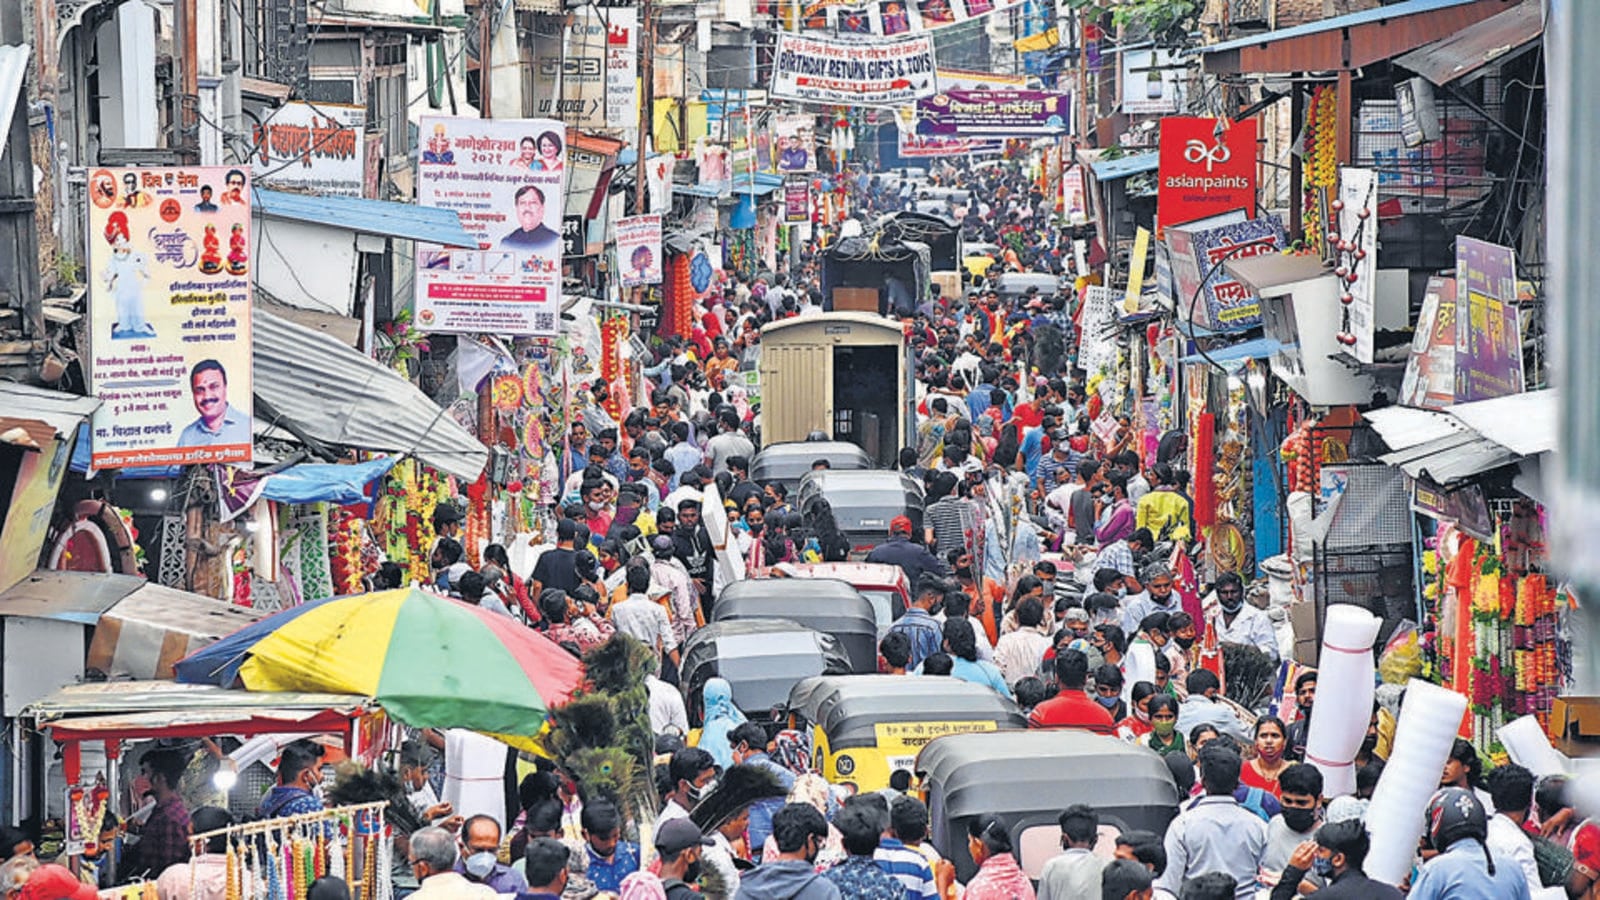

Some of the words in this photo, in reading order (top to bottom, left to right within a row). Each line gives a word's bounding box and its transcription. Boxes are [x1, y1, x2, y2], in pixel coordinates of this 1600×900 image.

[780, 51, 827, 77] BIRTHDAY
[829, 59, 865, 80] RETURN
[868, 60, 895, 79] GIFTS
[906, 53, 931, 75] TOYS
[454, 135, 516, 152] गणेशोत्सव
[471, 153, 503, 164] २०२१
[1165, 168, 1249, 193] asianpaints
